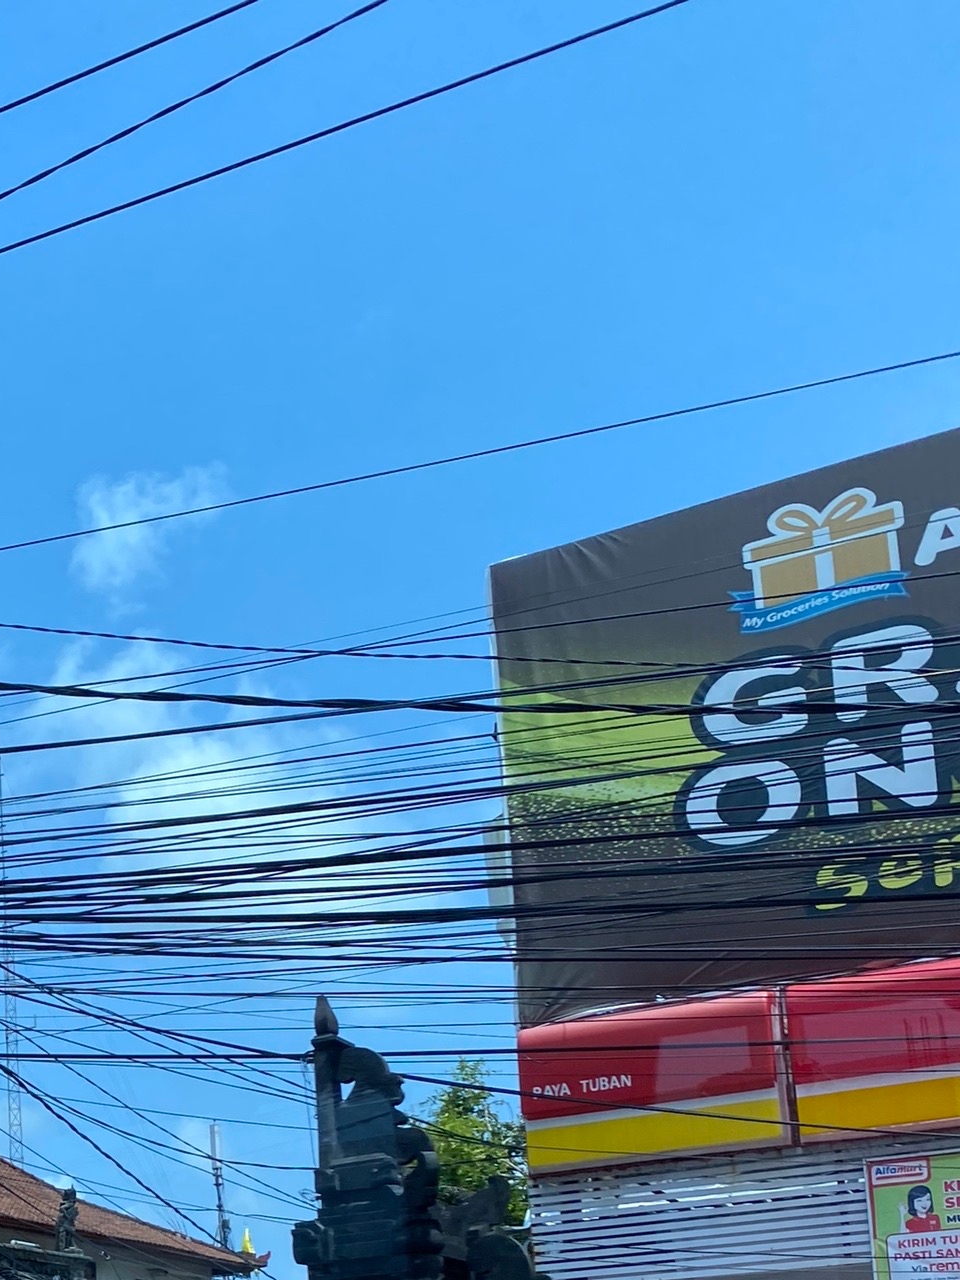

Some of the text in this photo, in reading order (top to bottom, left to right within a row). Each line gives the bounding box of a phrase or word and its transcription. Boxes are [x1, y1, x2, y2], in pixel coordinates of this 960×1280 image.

[742, 583, 890, 629] My Groceries Solution
[532, 1074, 632, 1099] RAYA TUBAN
[875, 1164, 923, 1176] Alfamart
[898, 1237, 937, 1249] KIRIM
[894, 1250, 932, 1261] PASTI
